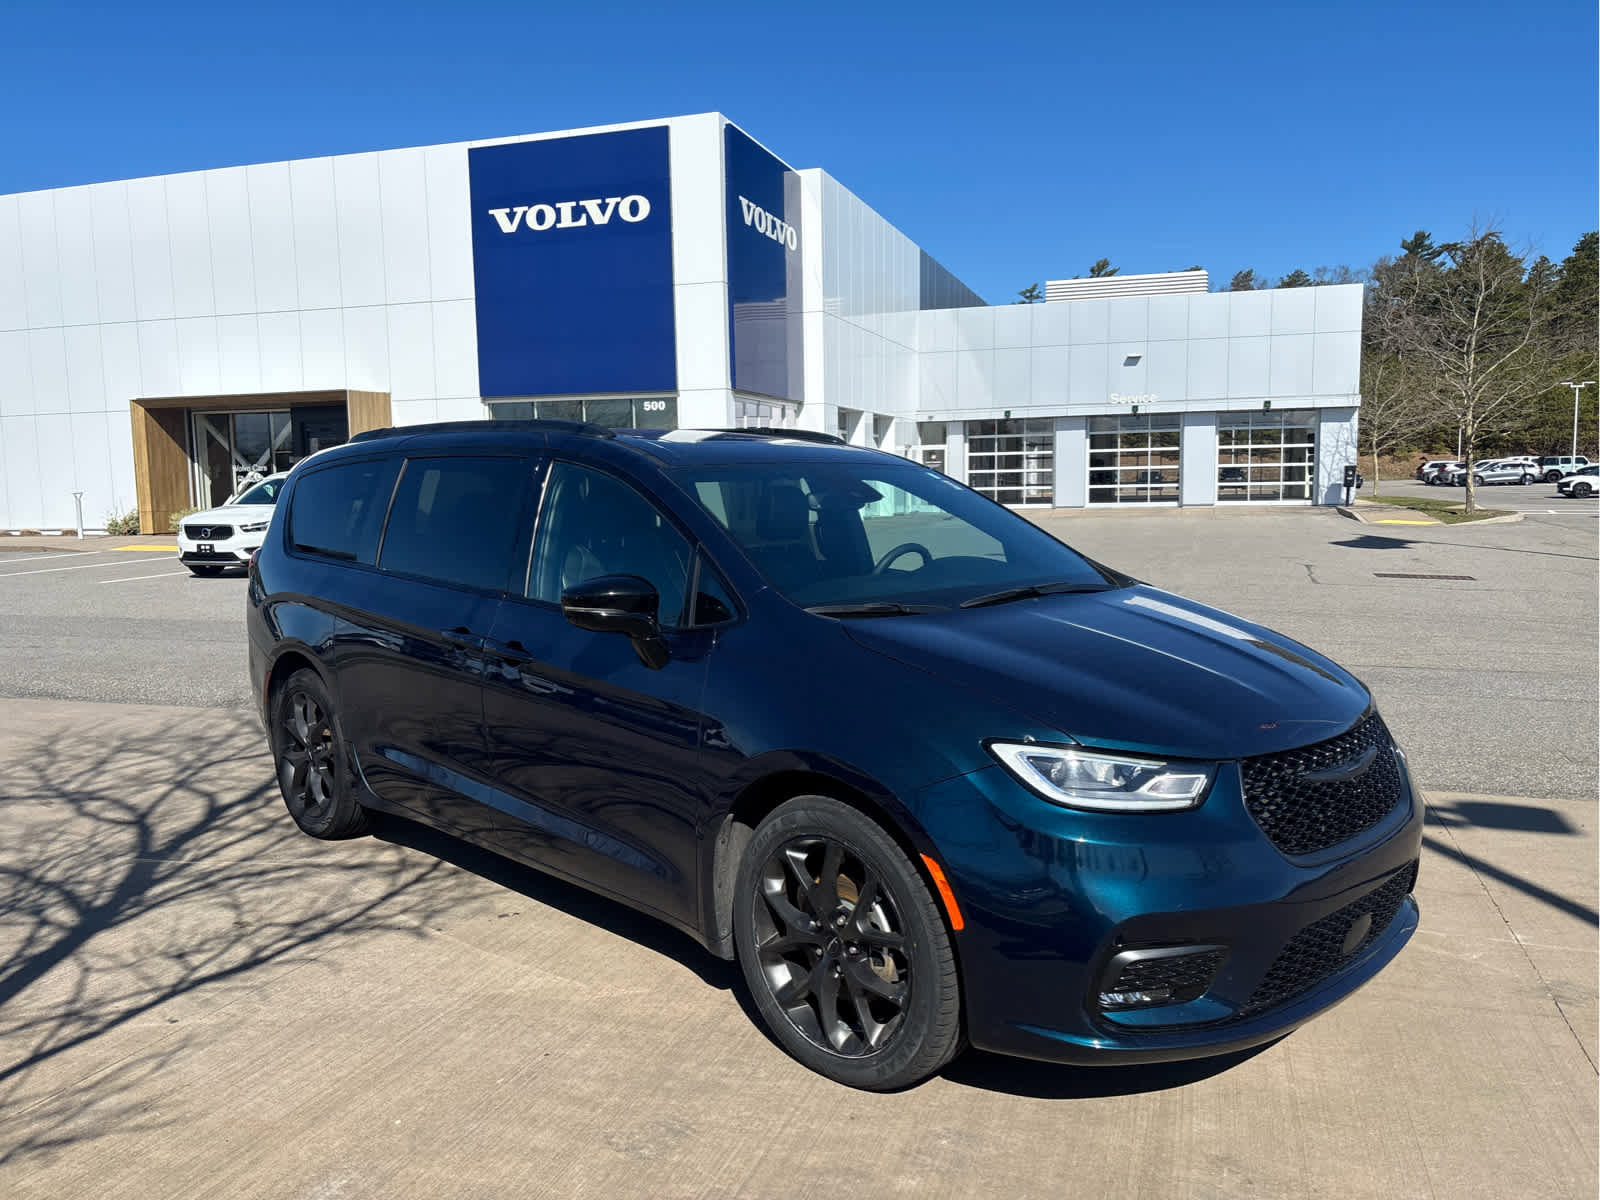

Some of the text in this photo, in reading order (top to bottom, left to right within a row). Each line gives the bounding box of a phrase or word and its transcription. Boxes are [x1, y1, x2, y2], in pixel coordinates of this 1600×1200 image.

[488, 194, 651, 233] VOLVO
[738, 195, 798, 251] VOLVO
[643, 400, 666, 411] 500
[1111, 392, 1160, 405] Service
